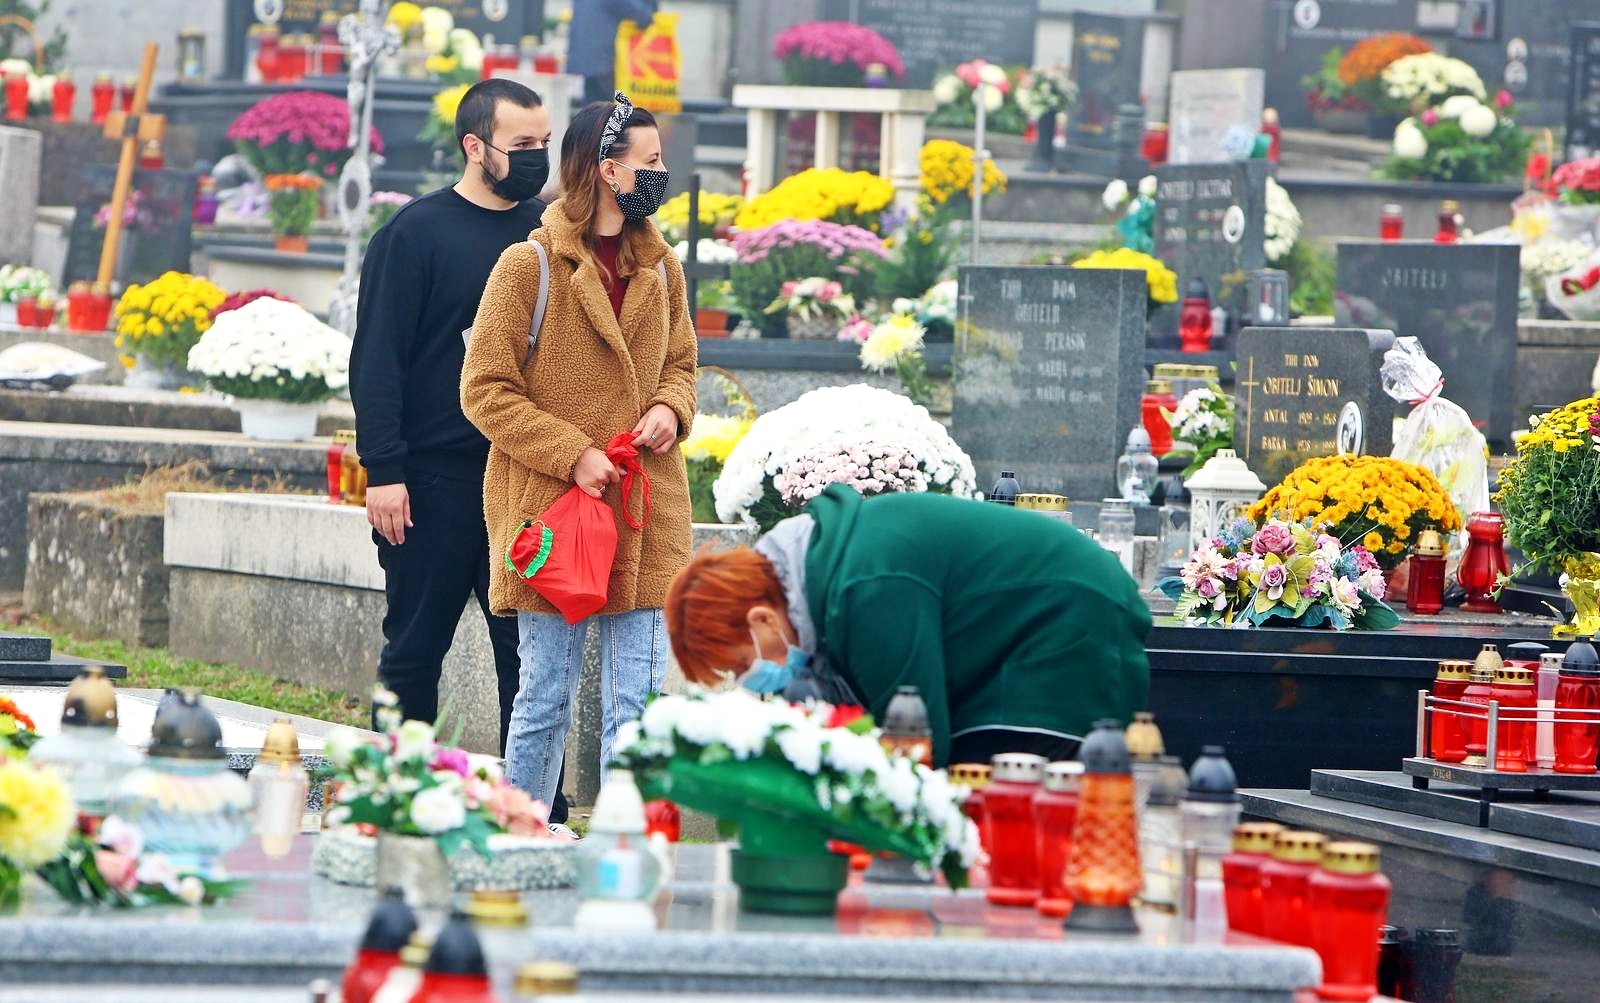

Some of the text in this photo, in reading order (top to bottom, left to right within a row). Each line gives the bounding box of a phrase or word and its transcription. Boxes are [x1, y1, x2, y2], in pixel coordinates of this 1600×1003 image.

[1381, 266, 1447, 289] OBITELJ
[1052, 279, 1077, 299] DOM
[1262, 374, 1340, 397] OBITELJ ŠIMON
[1263, 408, 1288, 424] ANTAL
